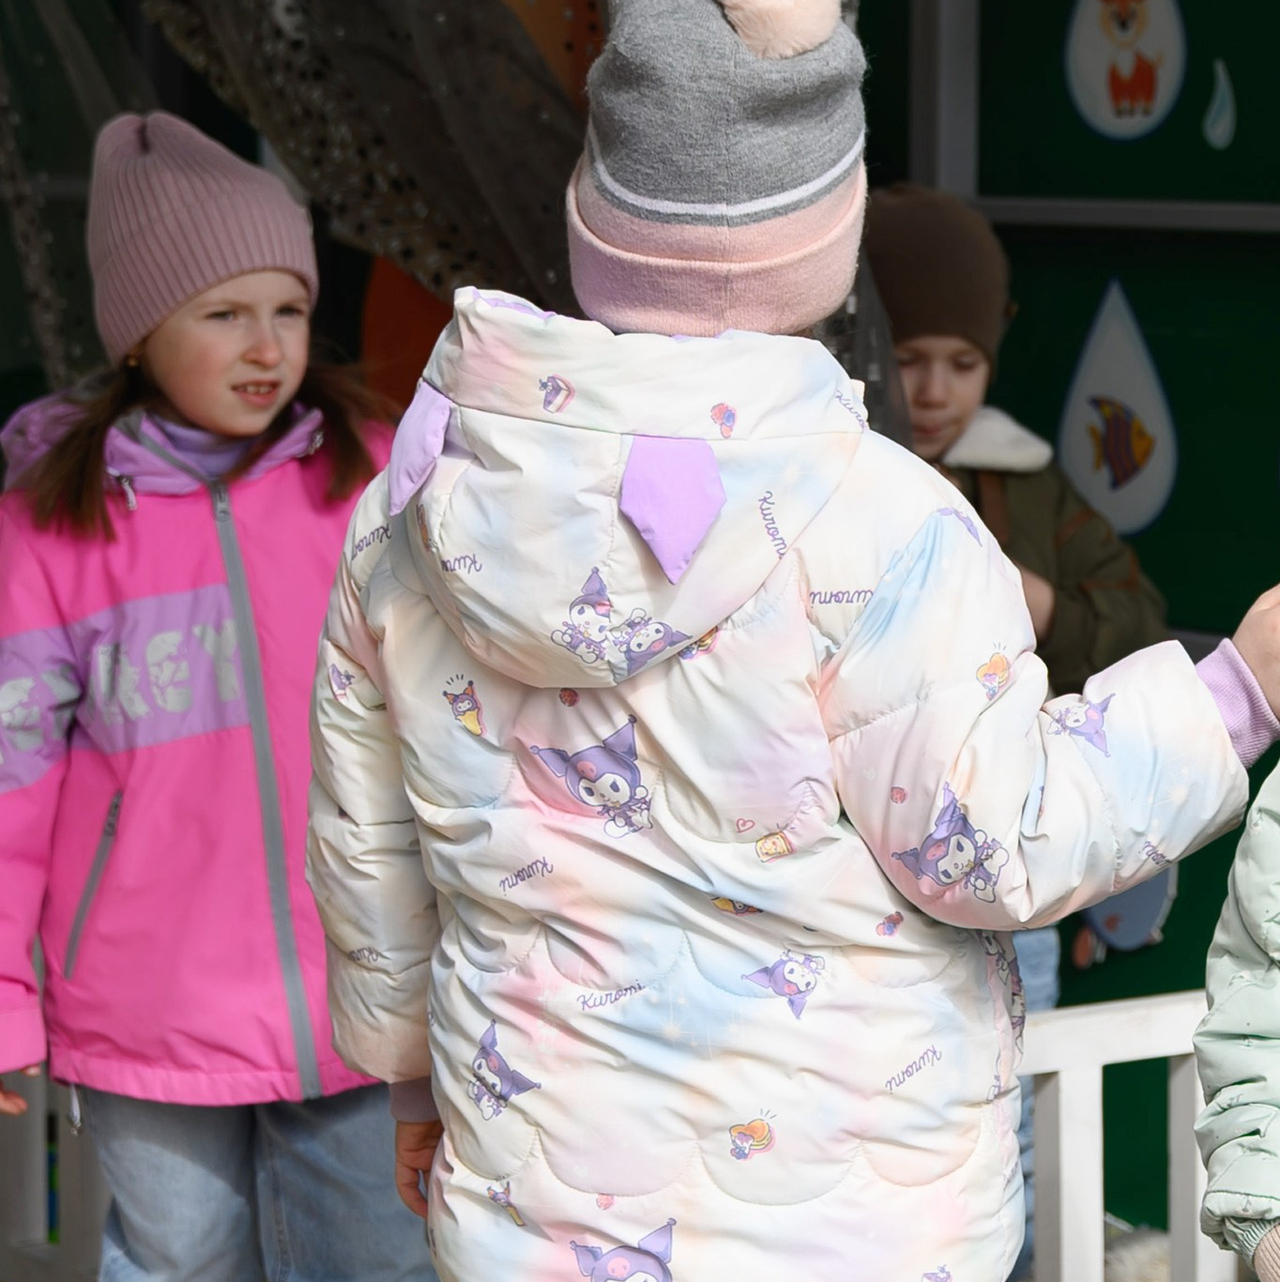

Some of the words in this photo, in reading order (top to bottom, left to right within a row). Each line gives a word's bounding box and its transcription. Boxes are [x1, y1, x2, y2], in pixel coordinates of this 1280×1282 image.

[499, 856, 554, 897] Kuromi
[576, 978, 647, 1012] Kuromi
[885, 1044, 943, 1096] Kuromi
